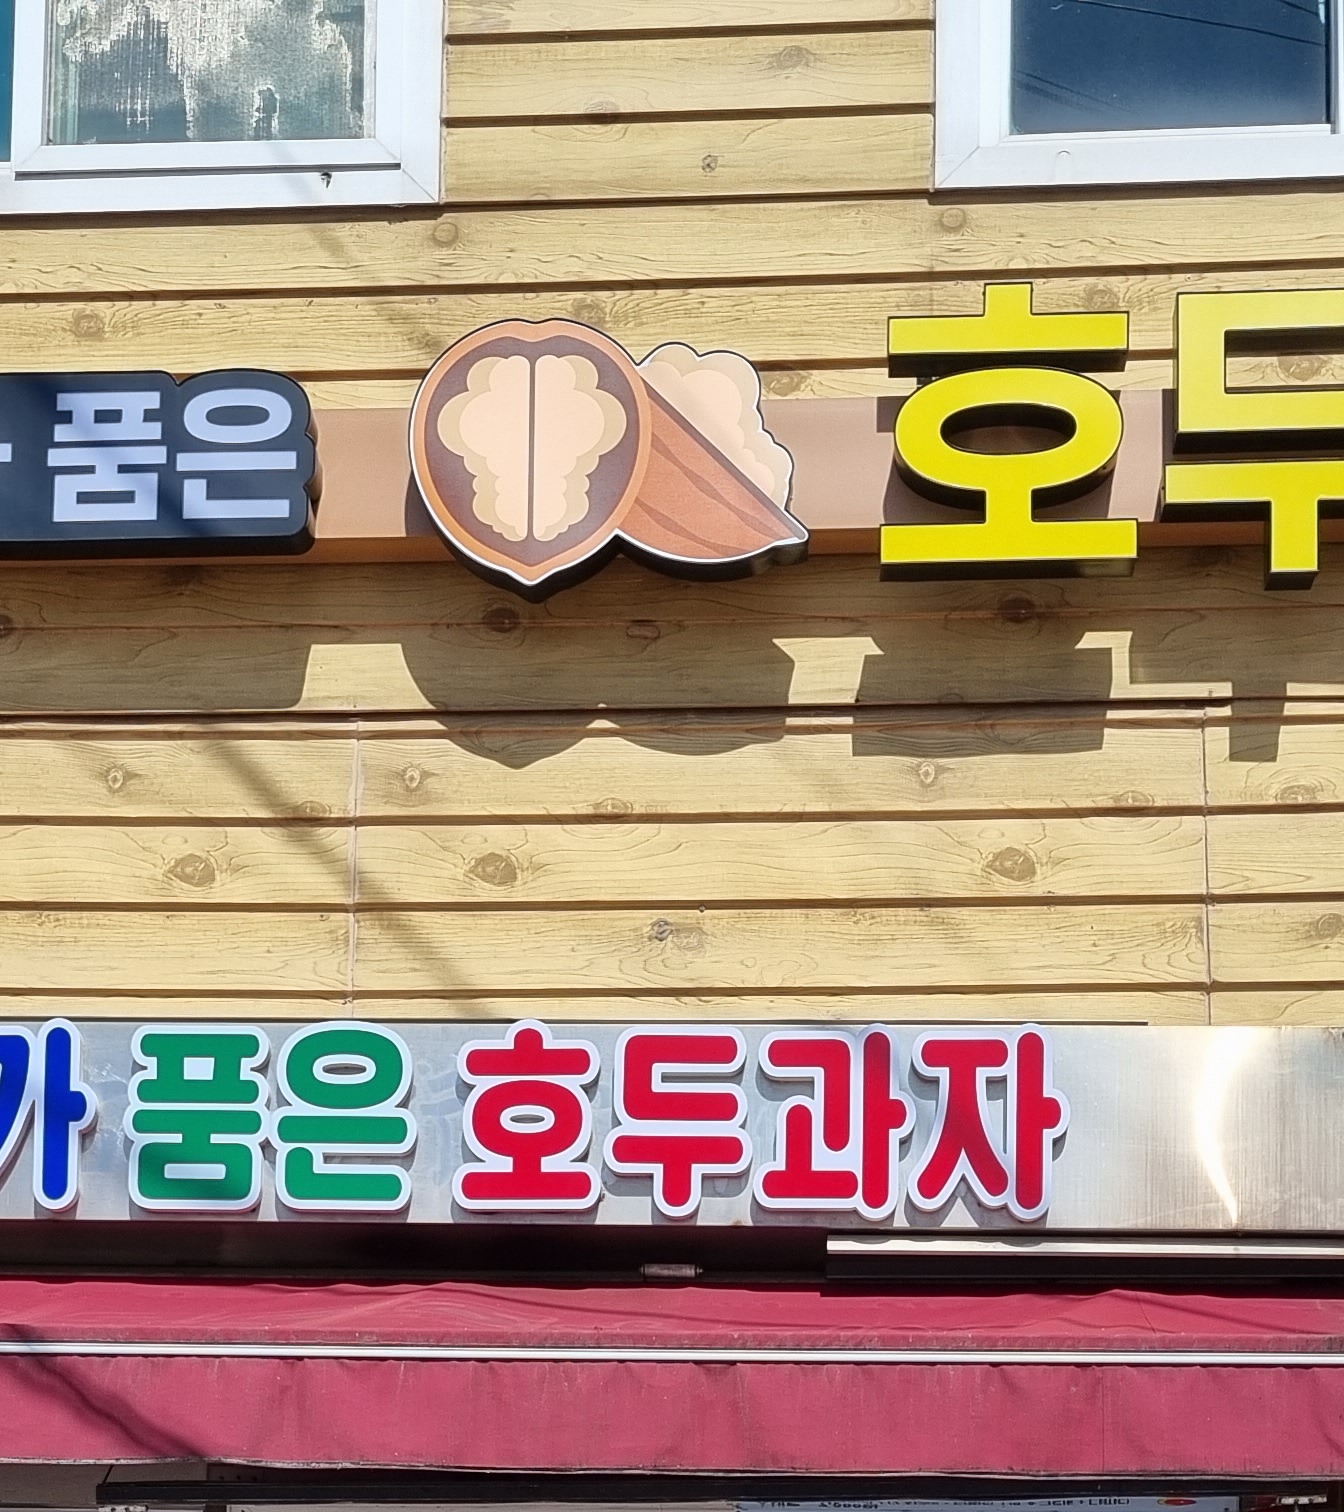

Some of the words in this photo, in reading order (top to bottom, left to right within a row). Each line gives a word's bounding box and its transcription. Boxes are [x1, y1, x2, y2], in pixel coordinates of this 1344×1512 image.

[46, 387, 297, 523] 품은
[128, 1023, 413, 1206] 품은
[458, 1023, 1066, 1213] 호두과자
